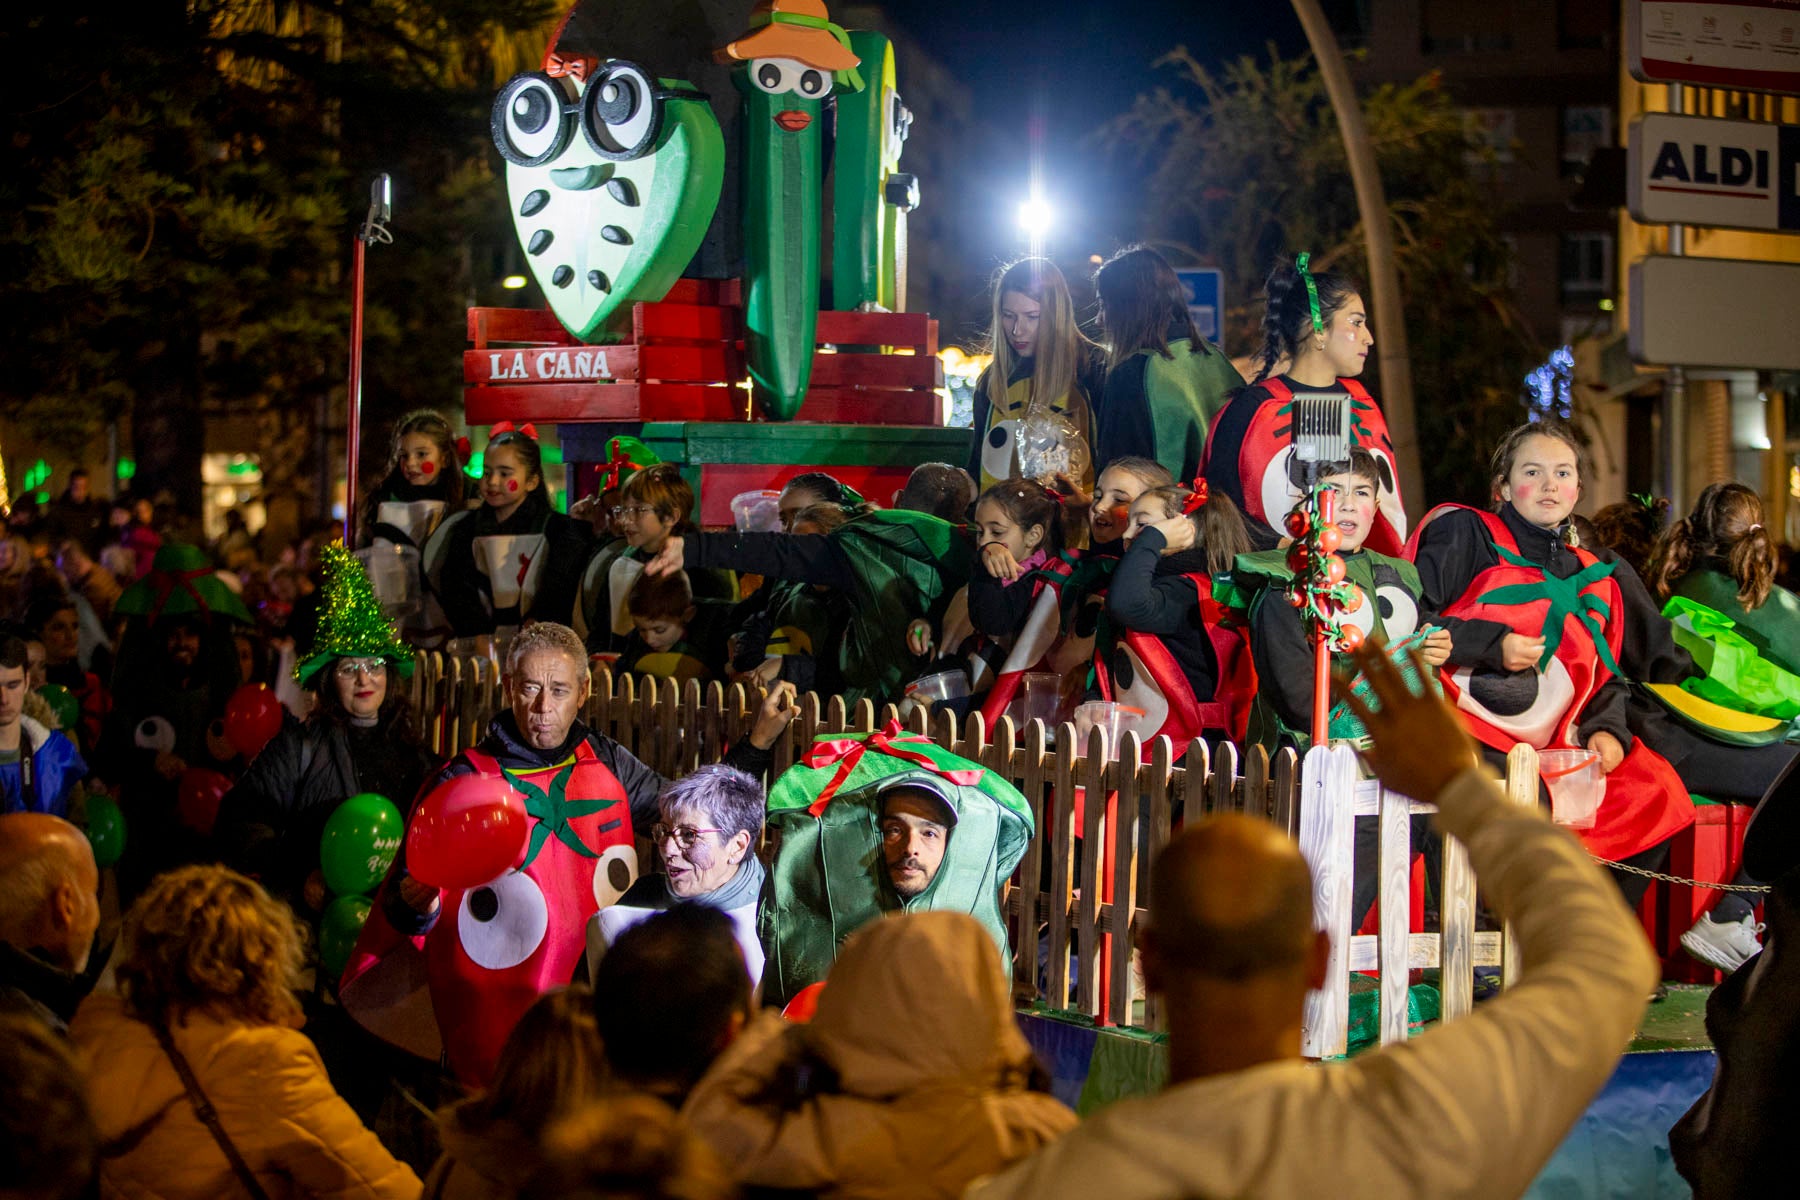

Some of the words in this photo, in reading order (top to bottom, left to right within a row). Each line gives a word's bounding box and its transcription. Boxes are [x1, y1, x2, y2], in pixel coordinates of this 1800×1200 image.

[1650, 142, 1769, 188] ALDI
[489, 352, 529, 380] LA
[536, 350, 612, 379] CAÑA
